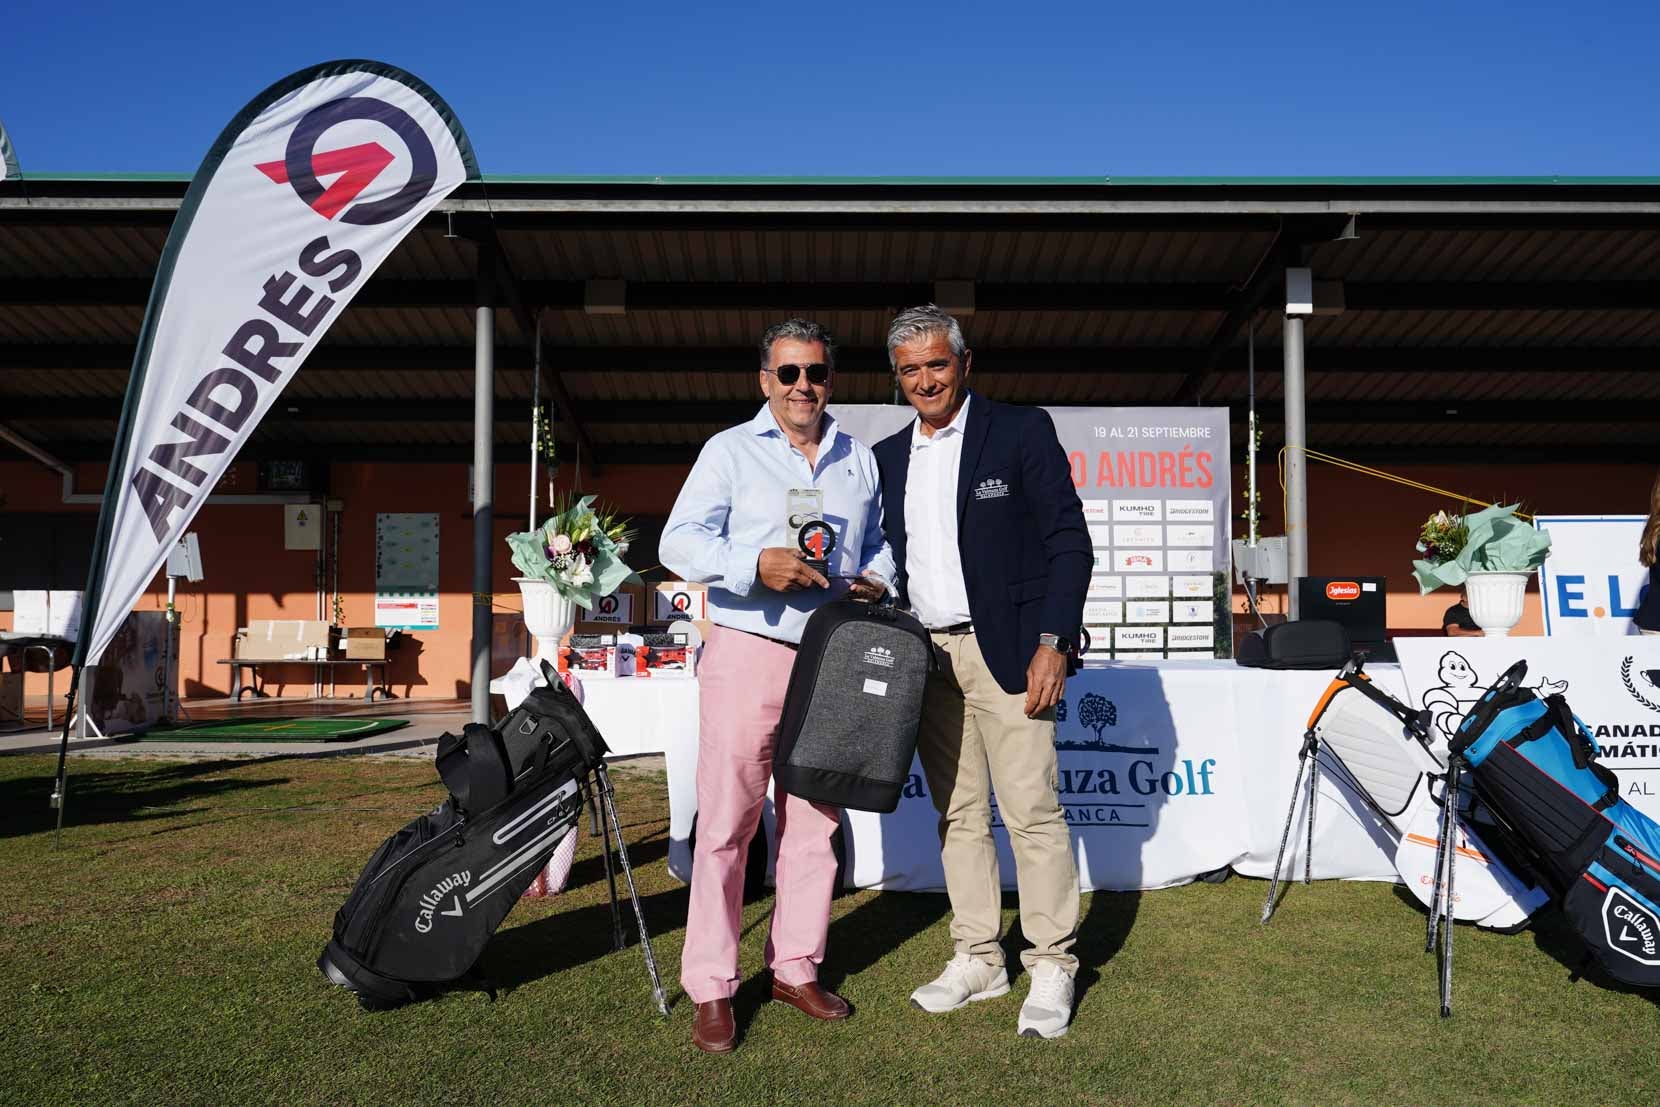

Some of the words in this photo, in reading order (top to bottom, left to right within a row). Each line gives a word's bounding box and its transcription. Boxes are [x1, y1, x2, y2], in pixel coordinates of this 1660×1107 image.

[132, 235, 362, 544] ANDRÉS
[1094, 426, 1106, 438] 19
[1110, 426, 1124, 438] AL
[1128, 426, 1138, 438] 21
[1142, 426, 1211, 438] SEPTIEMBRE
[1097, 443, 1214, 489] ANDRÉS
[1556, 575, 1648, 617] E.L
[1598, 741, 1660, 758] MÁTI
[1127, 758, 1216, 796] Golf
[1628, 781, 1655, 795] AL
[415, 870, 471, 933] Callaway
[1613, 905, 1656, 955] Callaway
